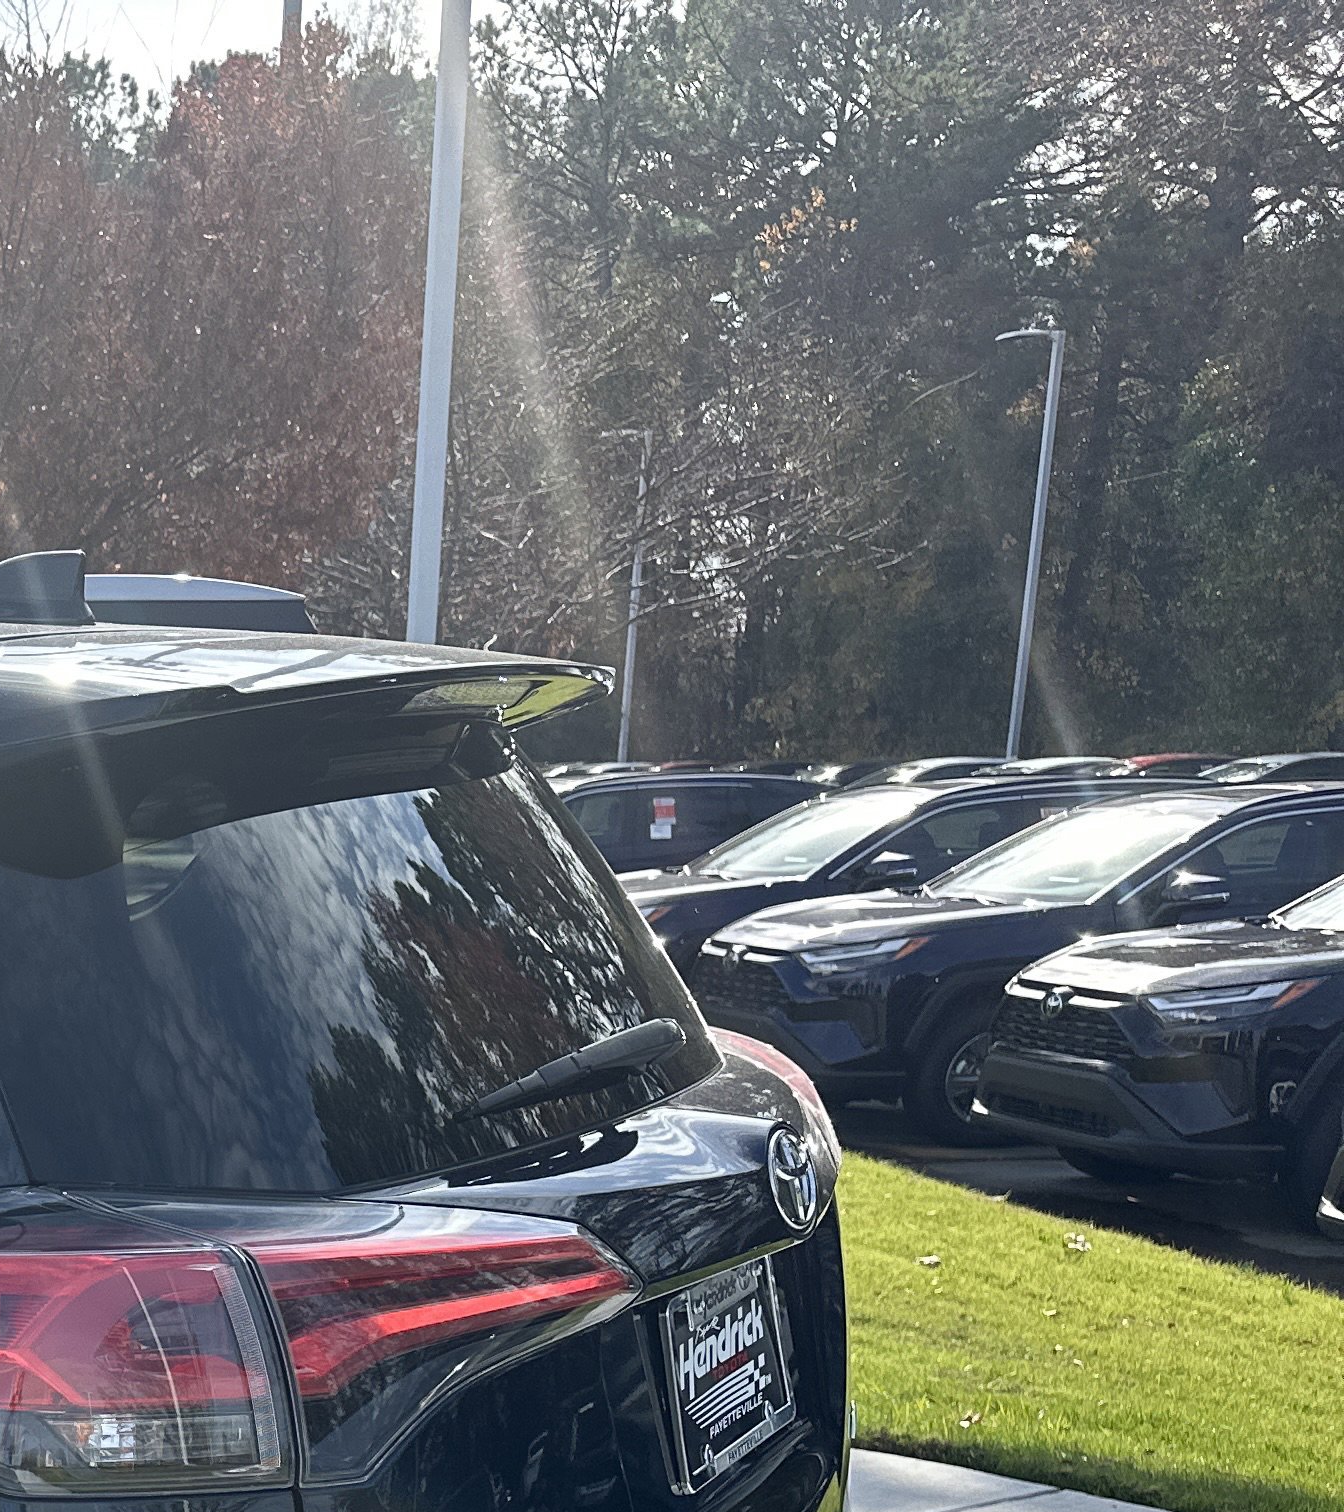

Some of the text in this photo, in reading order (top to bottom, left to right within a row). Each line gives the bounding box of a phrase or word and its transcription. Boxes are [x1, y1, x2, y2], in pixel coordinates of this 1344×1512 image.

[679, 1298, 764, 1401] Hendrick
[712, 1349, 749, 1380] TOYOTA
[709, 1391, 764, 1440] FAYETTEVILLE
